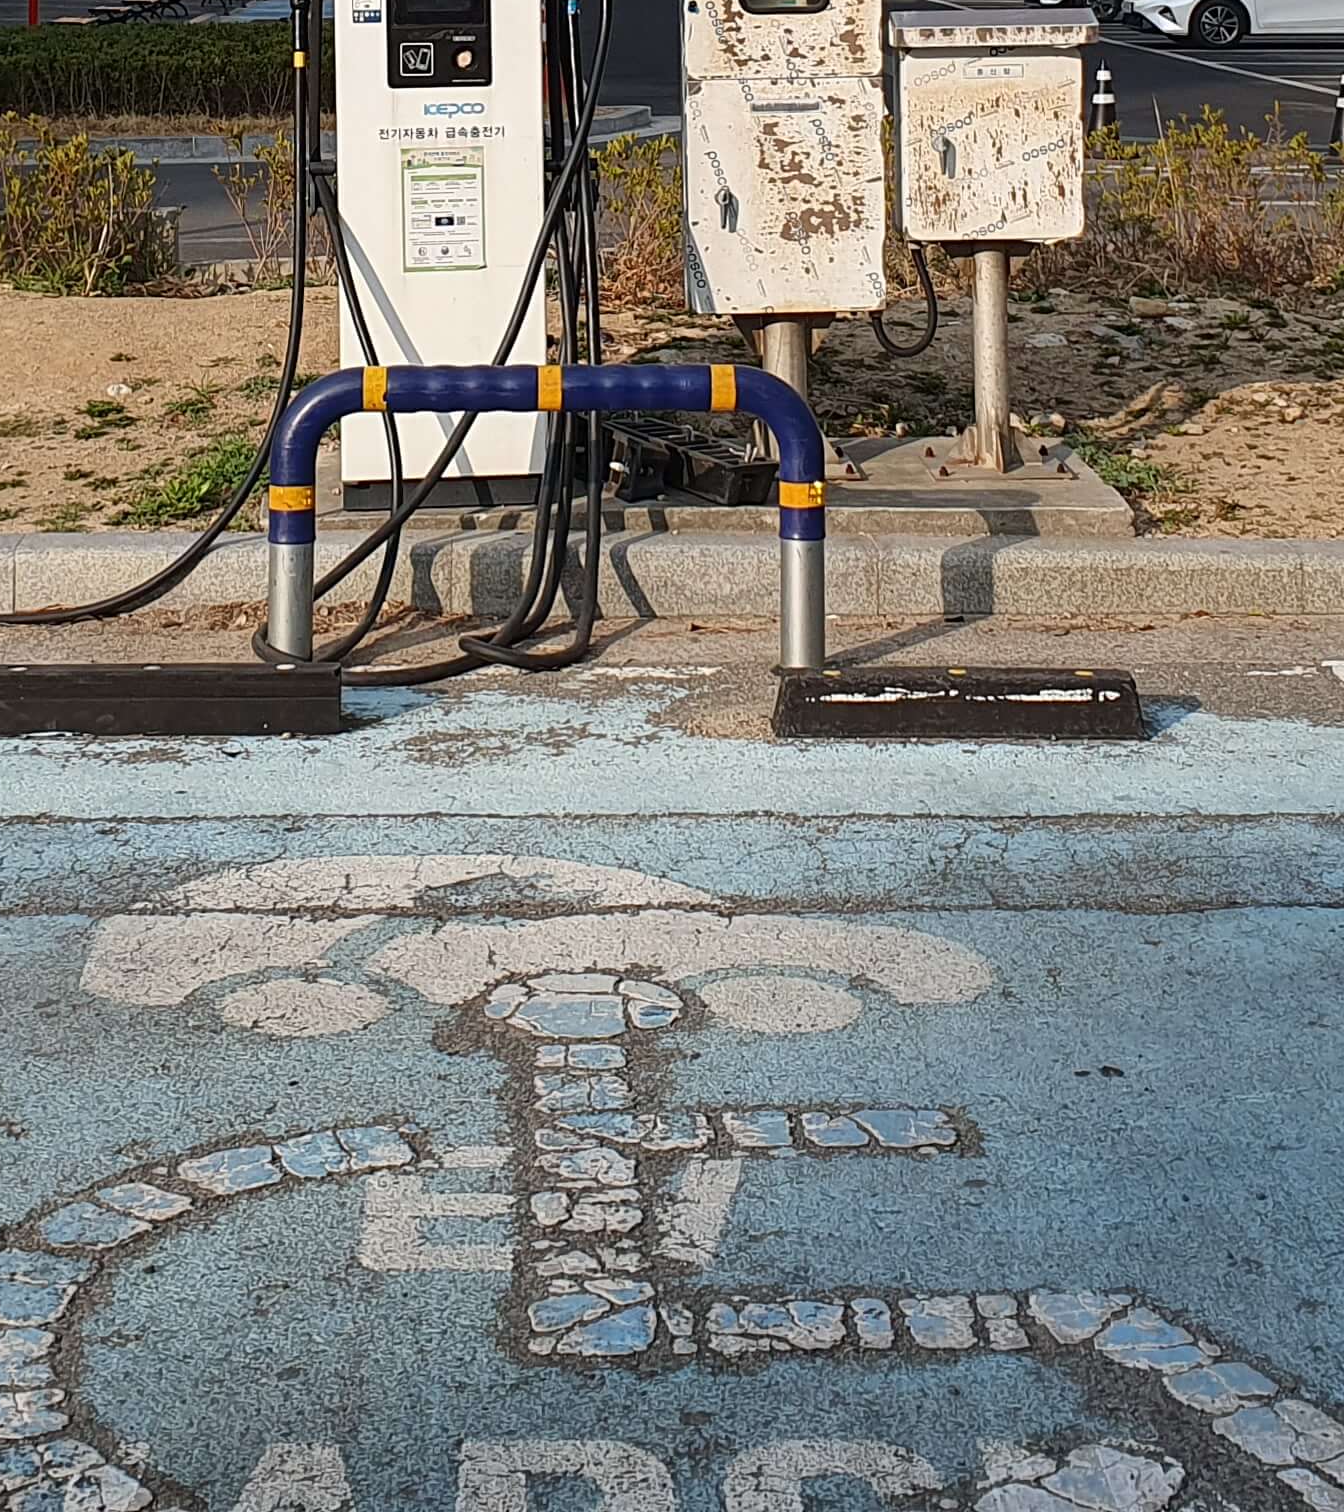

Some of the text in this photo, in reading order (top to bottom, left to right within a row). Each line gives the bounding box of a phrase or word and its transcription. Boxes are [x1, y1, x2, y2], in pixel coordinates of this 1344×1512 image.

[424, 103, 485, 119] KEPCO
[378, 125, 506, 140] 전기자동차 급속충전기
[1022, 137, 1067, 163] posco
